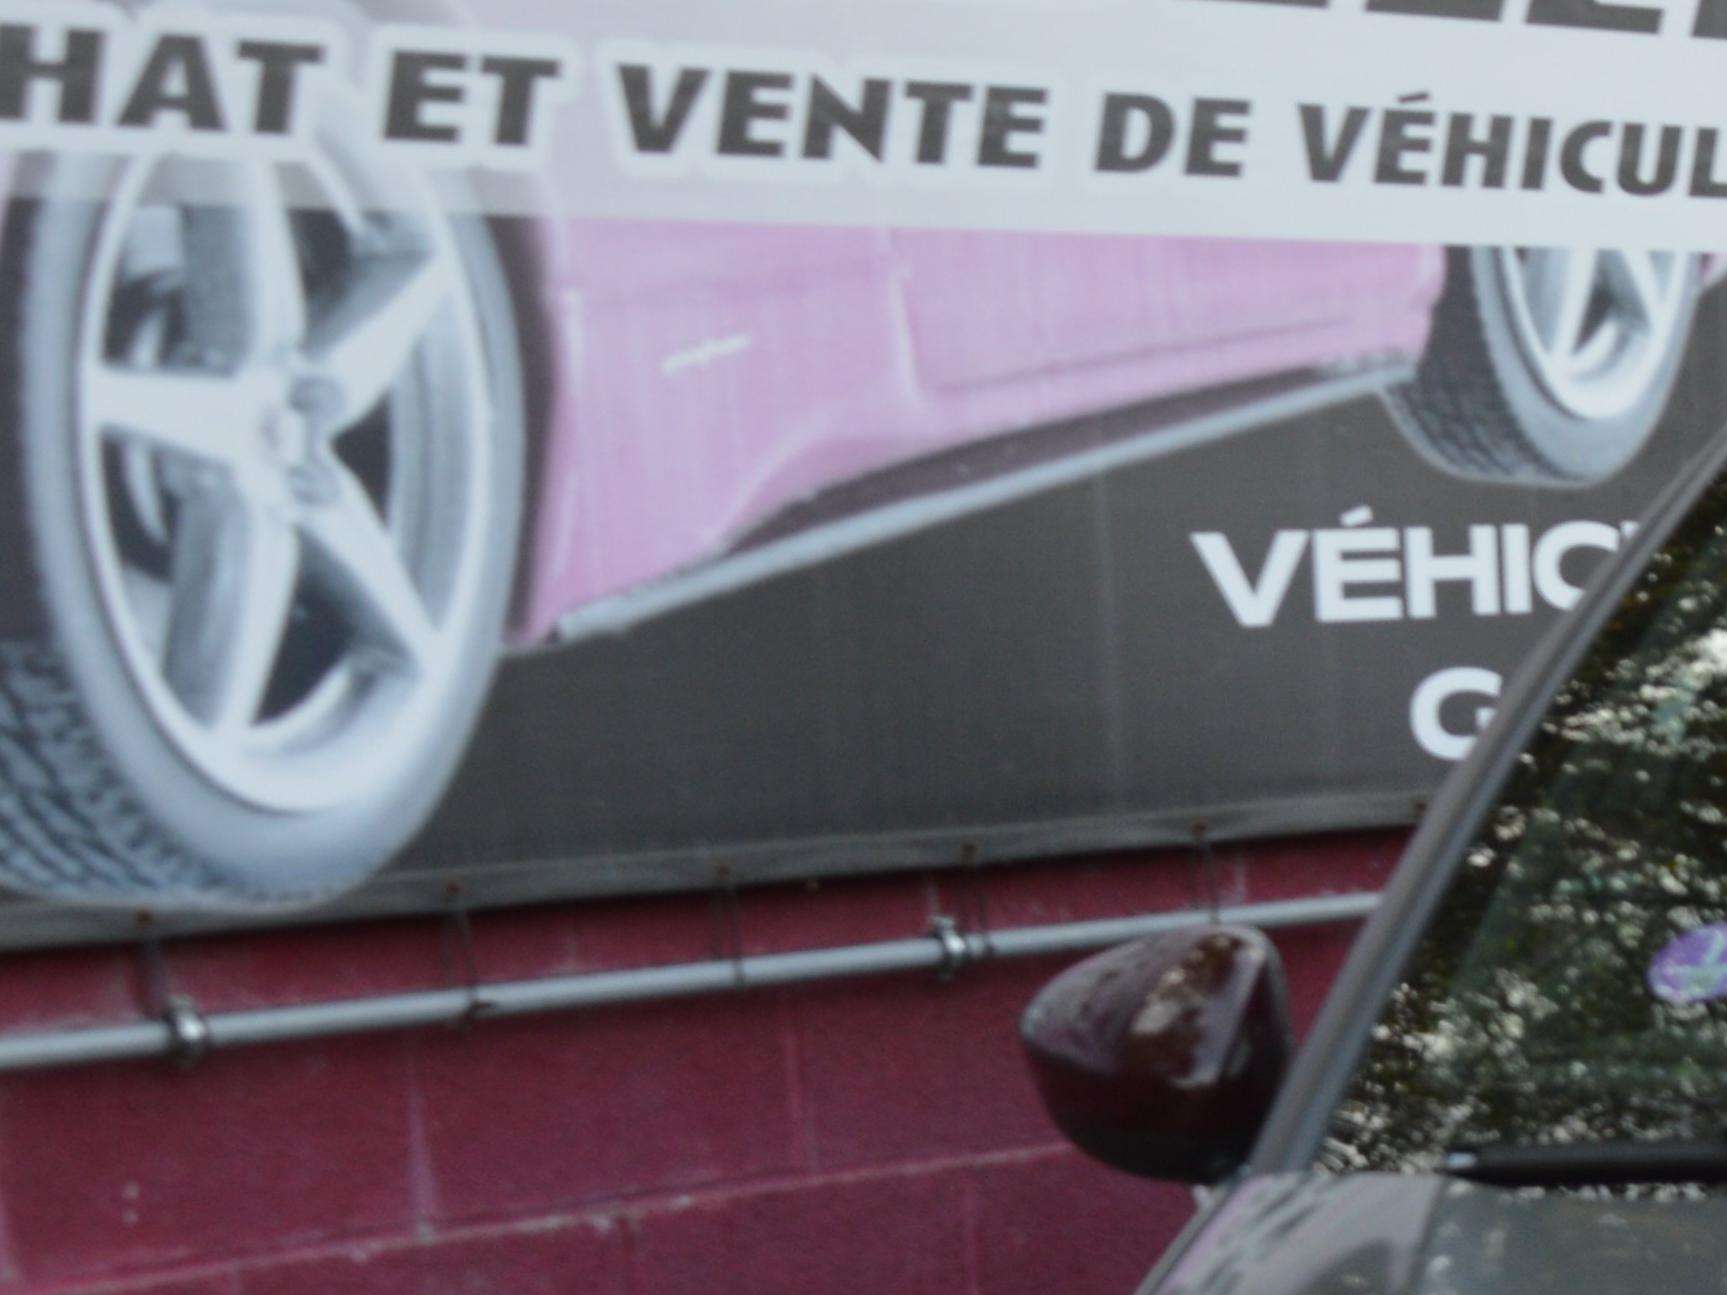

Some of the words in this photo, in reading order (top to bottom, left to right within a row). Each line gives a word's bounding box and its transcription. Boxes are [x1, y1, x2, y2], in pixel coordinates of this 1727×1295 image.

[383, 49, 562, 146] ET
[617, 63, 1049, 169] VENTE
[1095, 92, 1252, 178] DE
[1190, 505, 1638, 628] VÉHIC
